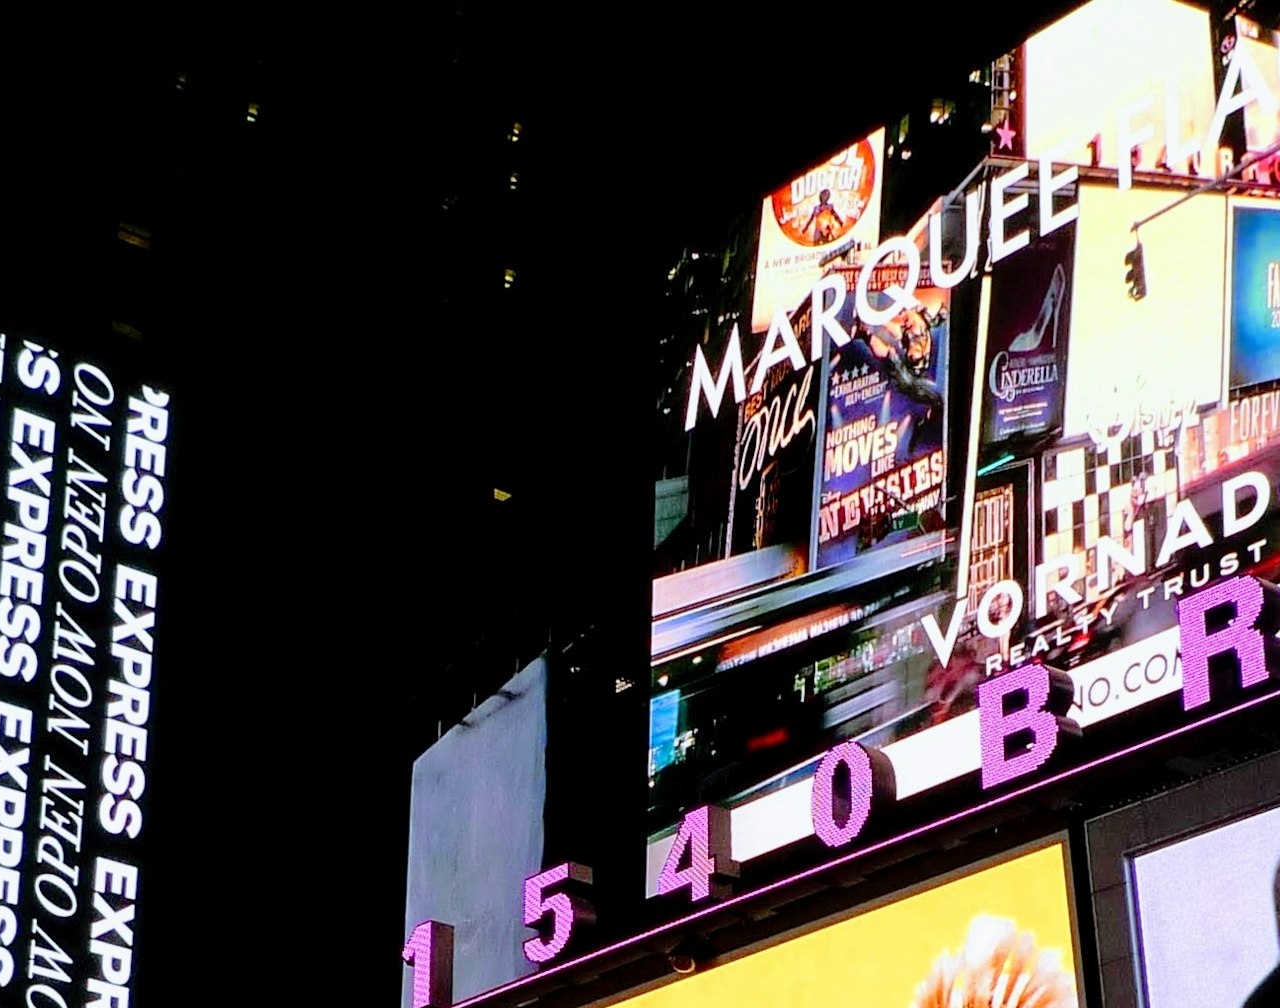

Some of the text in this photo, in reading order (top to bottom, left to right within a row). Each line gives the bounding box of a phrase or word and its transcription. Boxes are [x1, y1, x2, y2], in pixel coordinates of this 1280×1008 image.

[685, 142, 1079, 432] MARQUEE
[824, 421, 898, 481] MOVES
[826, 414, 876, 450] NOTHING
[871, 453, 895, 478] LIKE
[58, 447, 110, 604] OPEN
[45, 601, 97, 756] NOW
[985, 603, 1119, 676] REALTY
[1136, 537, 1269, 610] TRUST
[98, 562, 158, 840] EXPRESS
[33, 754, 87, 918] OPEN
